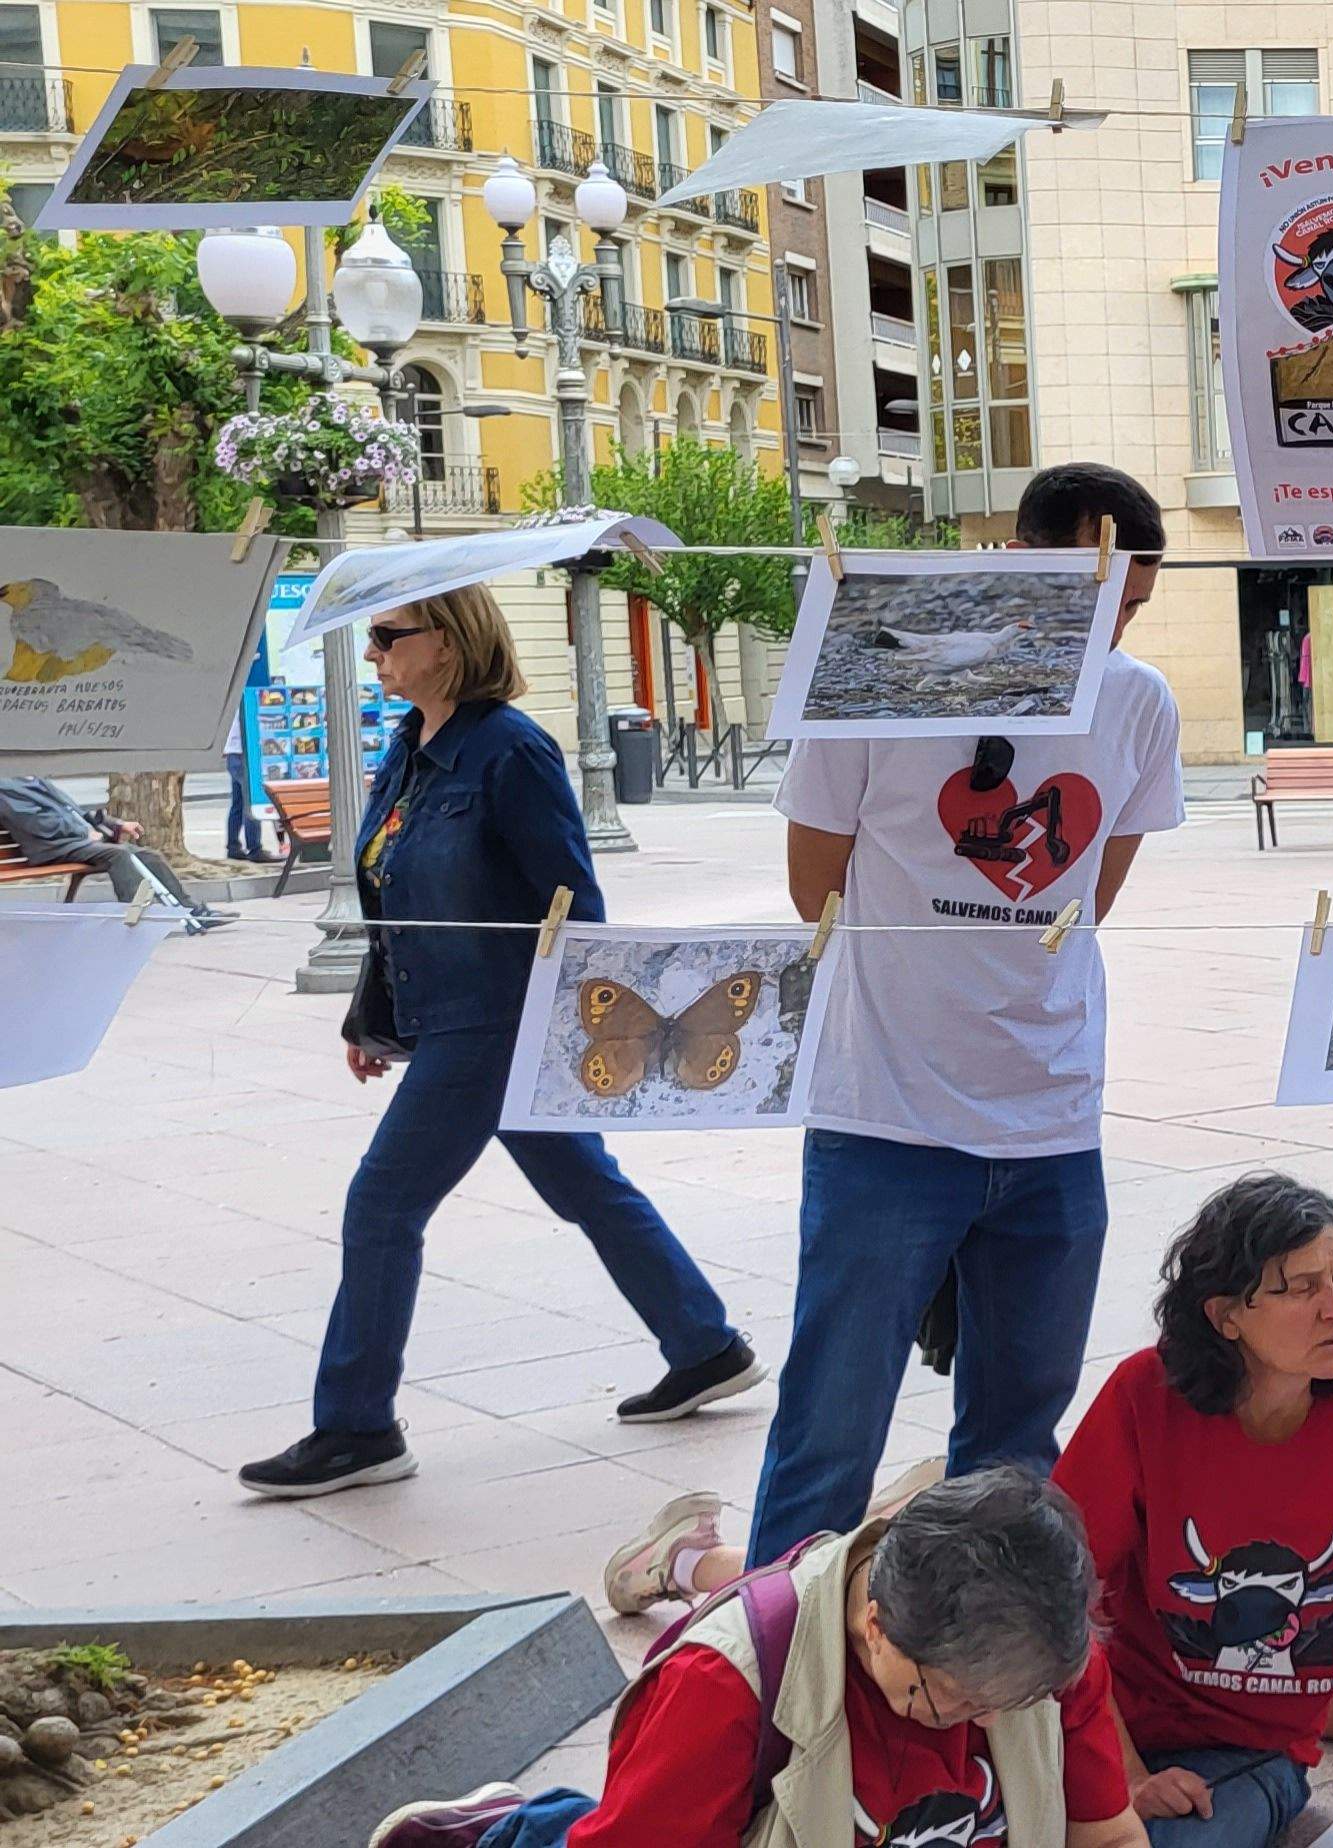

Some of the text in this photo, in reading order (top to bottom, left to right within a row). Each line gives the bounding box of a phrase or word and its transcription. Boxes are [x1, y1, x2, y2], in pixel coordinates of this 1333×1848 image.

[1306, 401, 1331, 410] Parque
[1273, 484, 1303, 503] ¡Te
[931, 898, 1011, 924] SALVEMOS
[1246, 1675, 1303, 1694] CANAL
